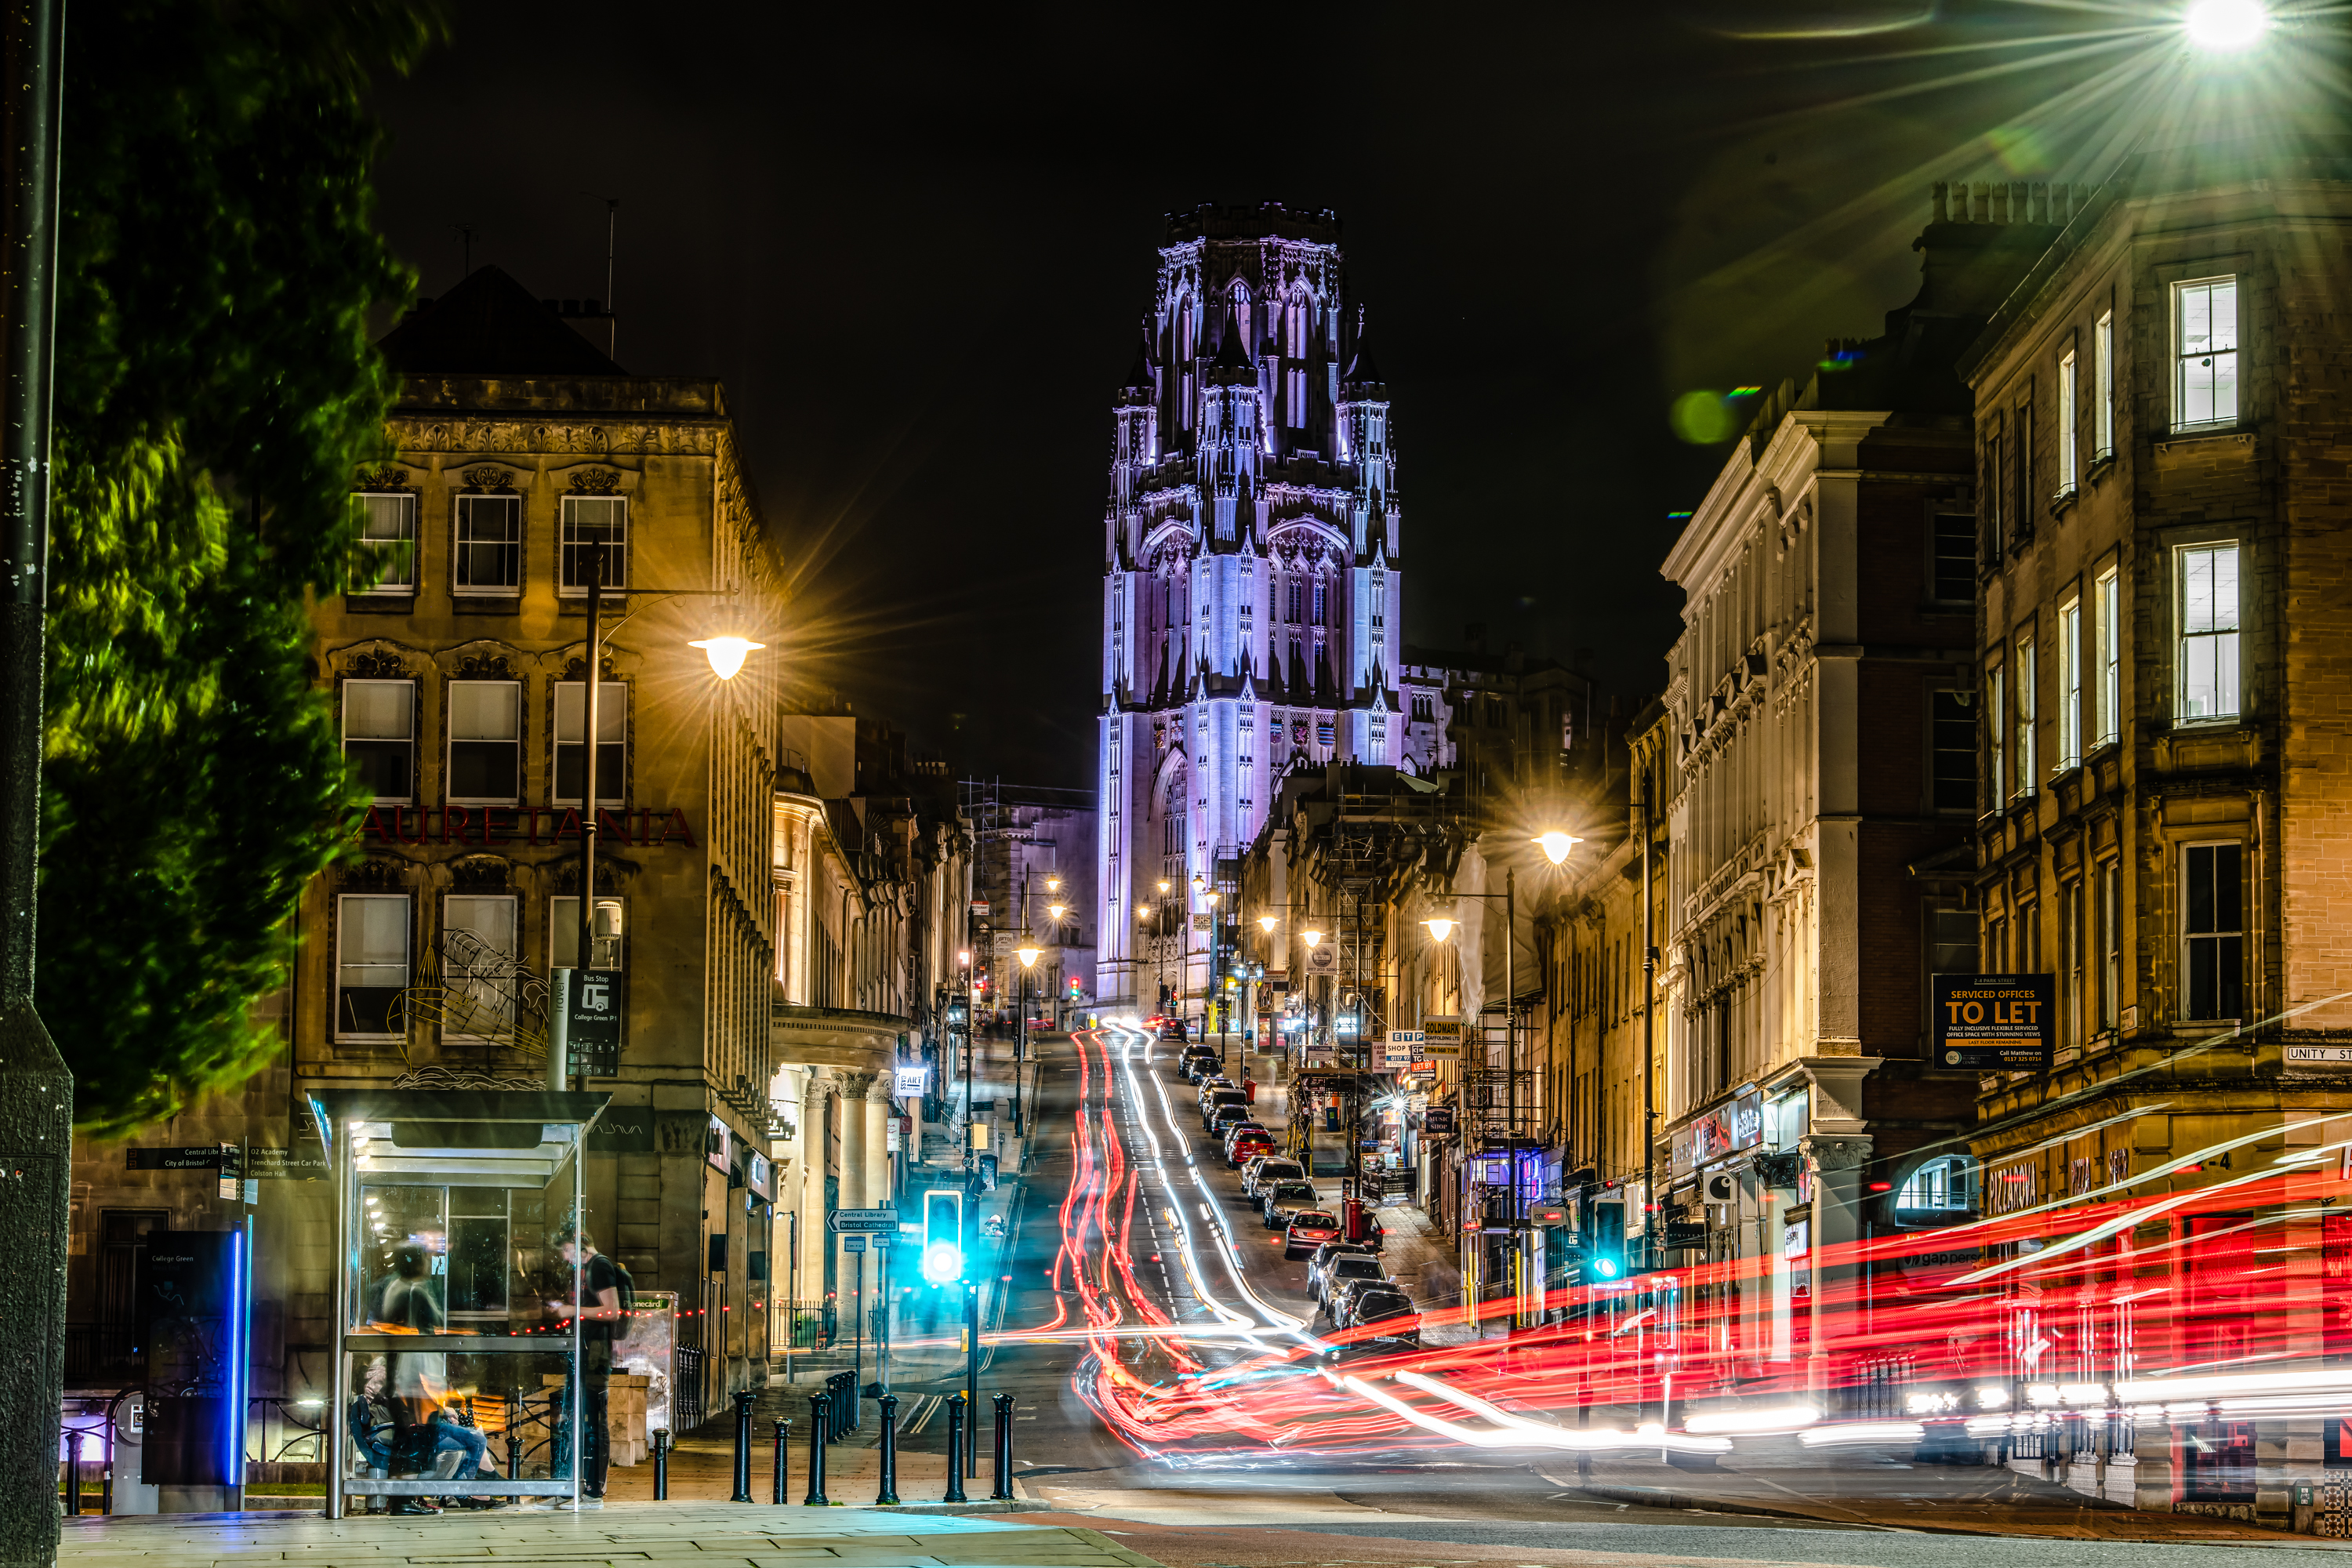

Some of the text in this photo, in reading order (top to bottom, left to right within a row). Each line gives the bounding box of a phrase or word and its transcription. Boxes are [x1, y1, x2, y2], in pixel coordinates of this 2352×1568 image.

[1194, 915, 1210, 924] SRS
[596, 975, 608, 984] Stop
[555, 982, 564, 1013] travel
[1951, 990, 1995, 999] SERVICED
[1946, 1001, 2042, 1024] TO LET
[1425, 1023, 1459, 1034] GOLDMARK
[2290, 1049, 2326, 1059] UNITY
[1989, 1161, 2036, 1214] PIZZAROVA
[2071, 1156, 2090, 1197] PIZZA
[1922, 1254, 1948, 1266] gap
